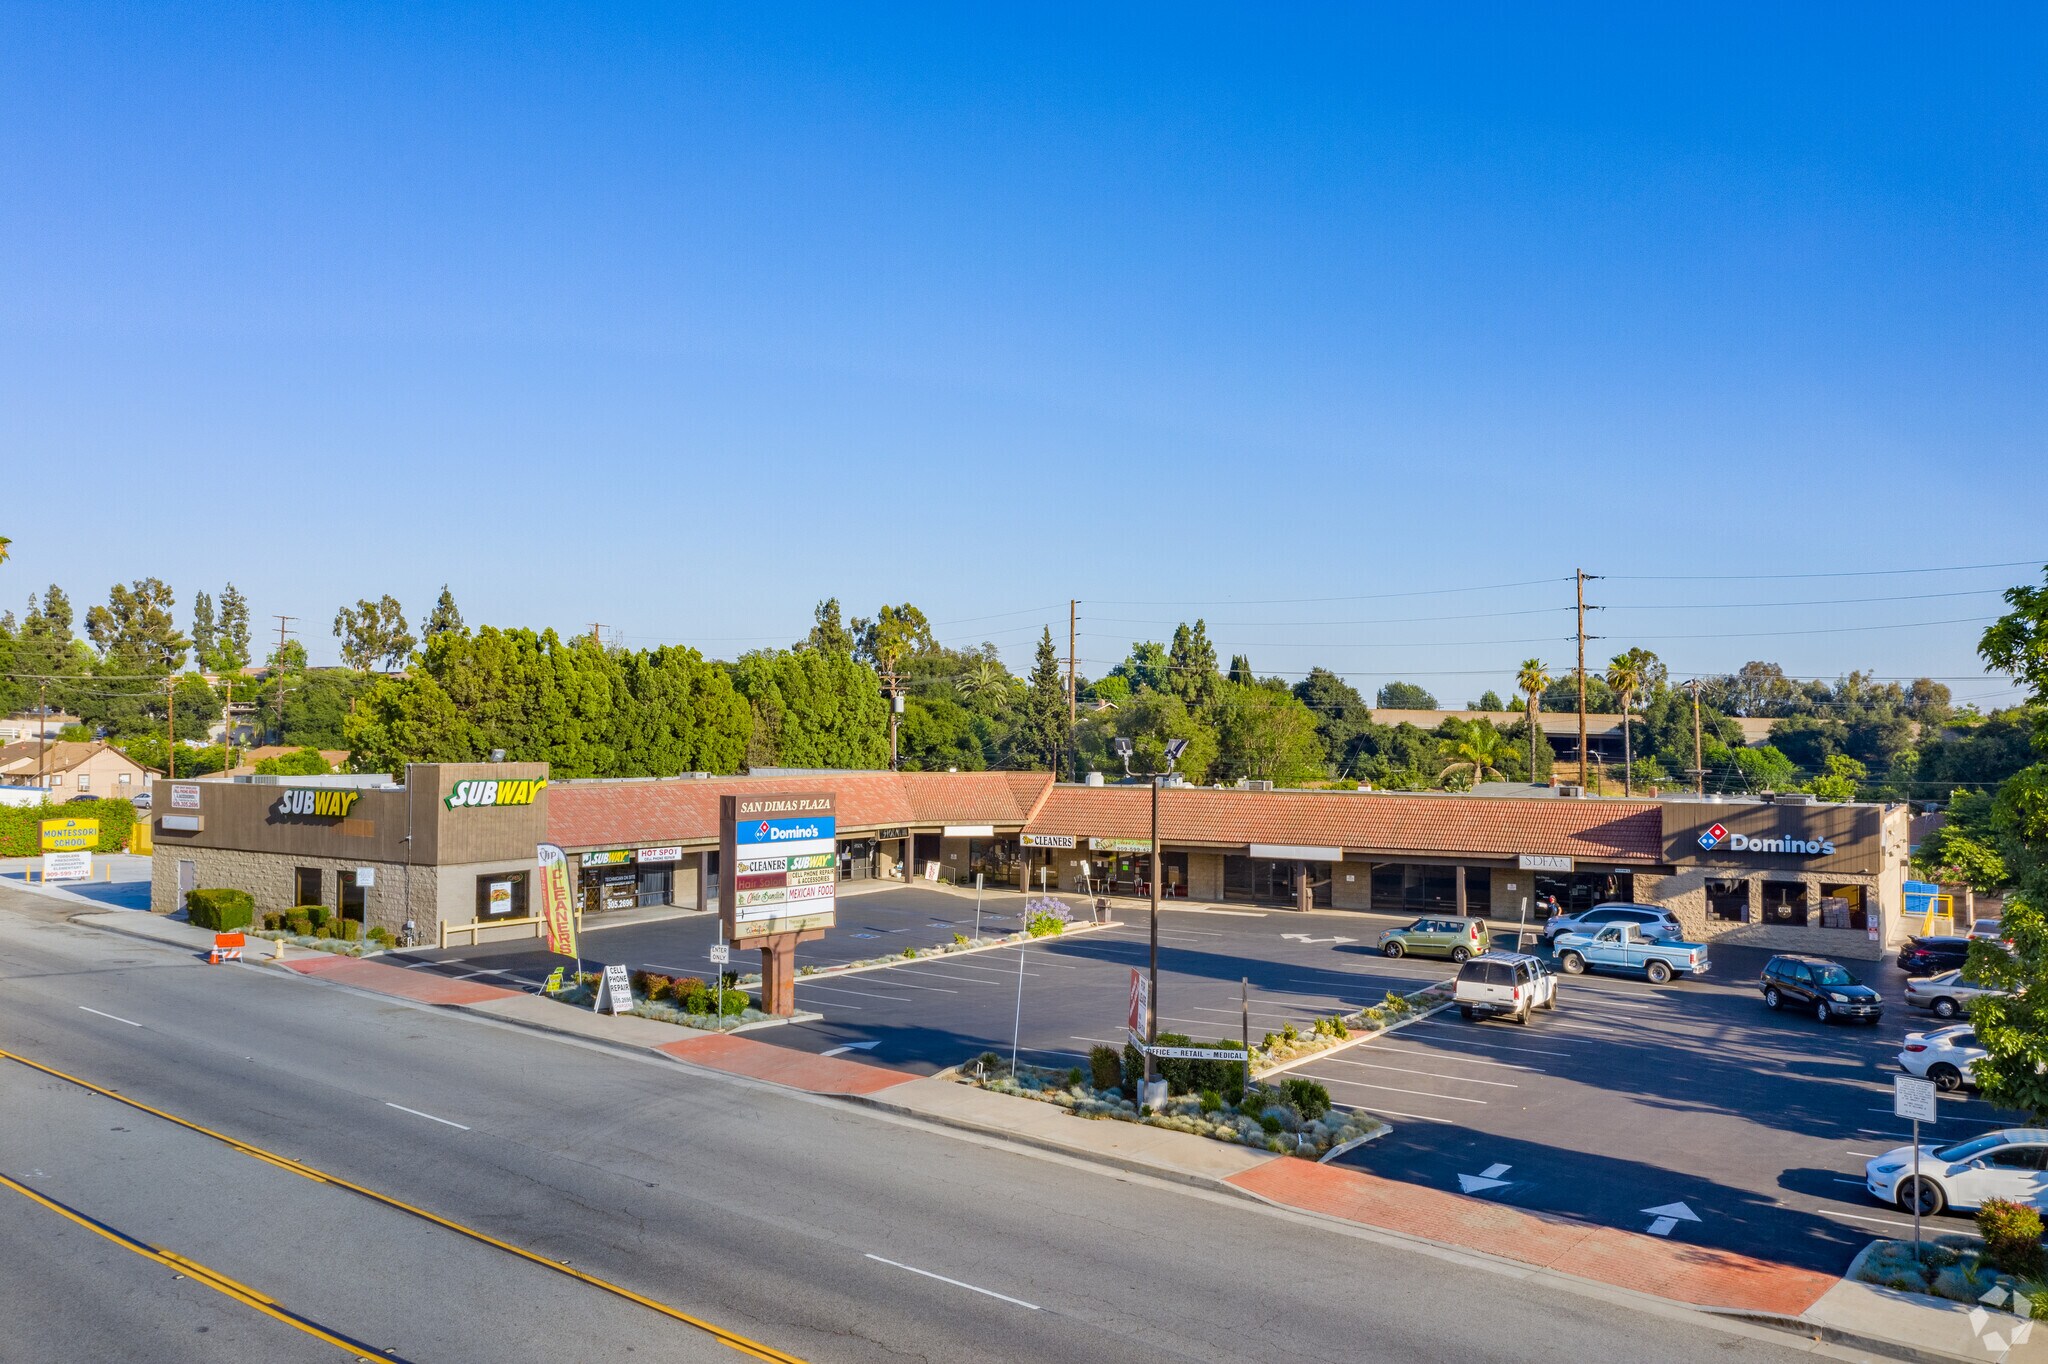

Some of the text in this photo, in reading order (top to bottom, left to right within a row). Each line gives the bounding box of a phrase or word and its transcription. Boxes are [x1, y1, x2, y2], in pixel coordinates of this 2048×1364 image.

[446, 777, 548, 808] SUBWAY
[278, 788, 359, 817] SUBWAY
[740, 799, 831, 814] SAN DIMAS PLAZA
[43, 827, 97, 838] MONTESSORI
[770, 824, 819, 840] Domino's
[54, 838, 87, 847] SCHOOL
[1034, 835, 1072, 847] CLEANERS
[1730, 833, 1837, 855] Domino's
[591, 850, 629, 865] SUBWAY
[641, 848, 678, 857] HOT SPOT
[749, 860, 786, 872] CLEANERS
[790, 854, 832, 869] SUBWAY
[738, 880, 757, 889] Hair
[759, 878, 785, 888] Salon
[788, 885, 834, 899] MEXICAN FOOD
[551, 868, 572, 955] CLEANERS
[609, 966, 624, 974] CELL
[608, 975, 628, 983] PHONE
[610, 983, 630, 992] REPAIR
[1213, 1051, 1243, 1059] MEDICAL
